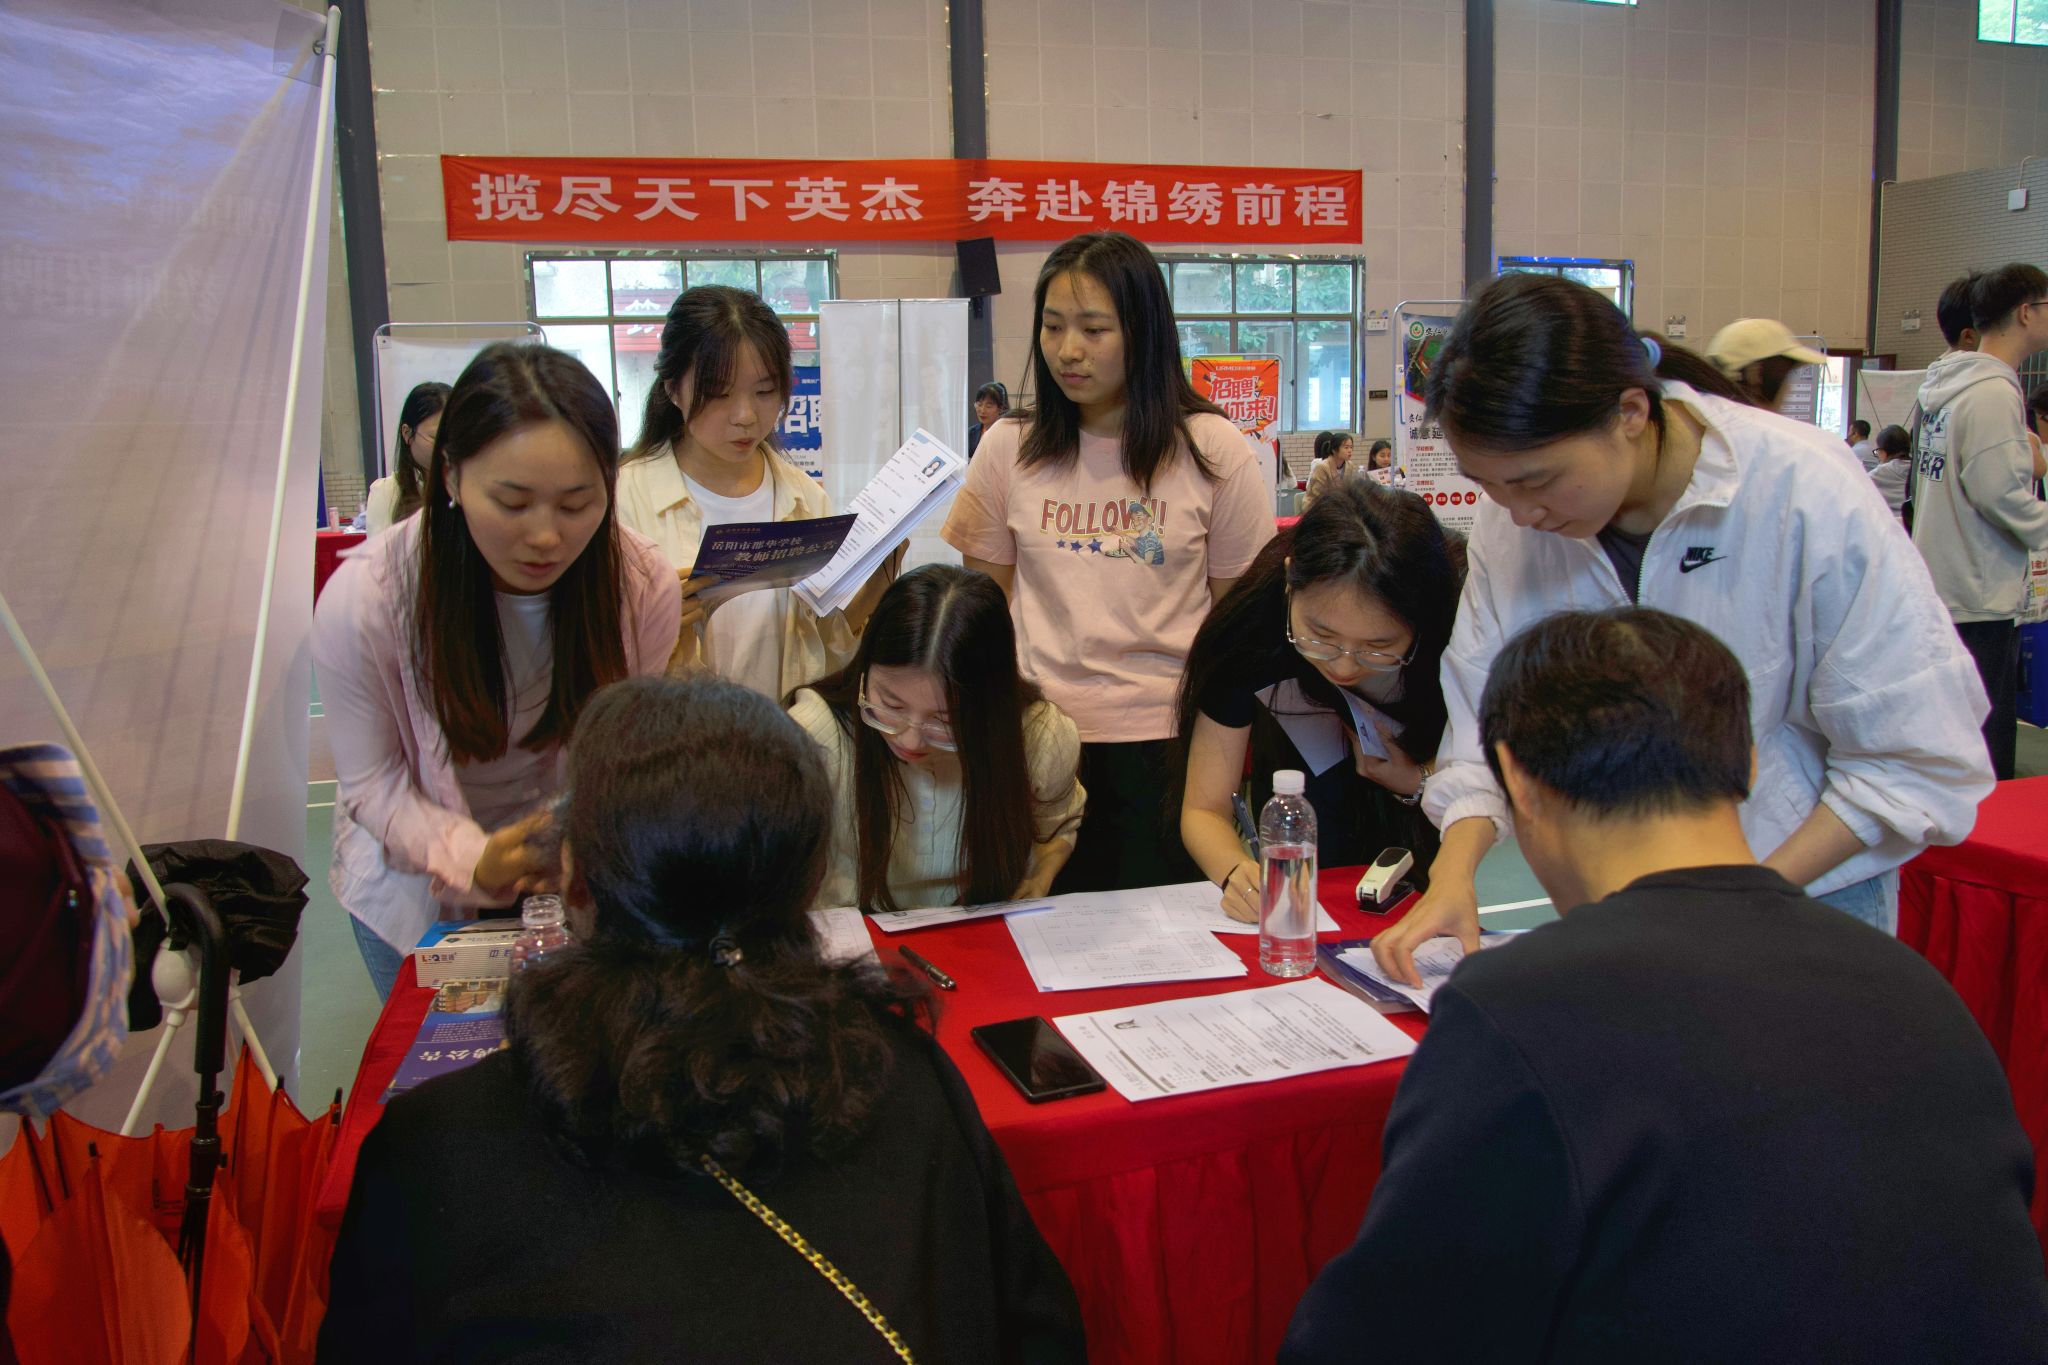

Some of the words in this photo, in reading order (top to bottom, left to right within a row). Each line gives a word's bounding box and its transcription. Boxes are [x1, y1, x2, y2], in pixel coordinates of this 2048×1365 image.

[472, 173, 924, 222] 揽尽天下英杰
[968, 177, 1349, 226] 奔赴锦绣前程
[1210, 376, 1255, 402] 招聘
[1218, 396, 1276, 420] 你来!
[733, 540, 838, 562] 教师招聘公告
[1685, 546, 1715, 561] NIKE
